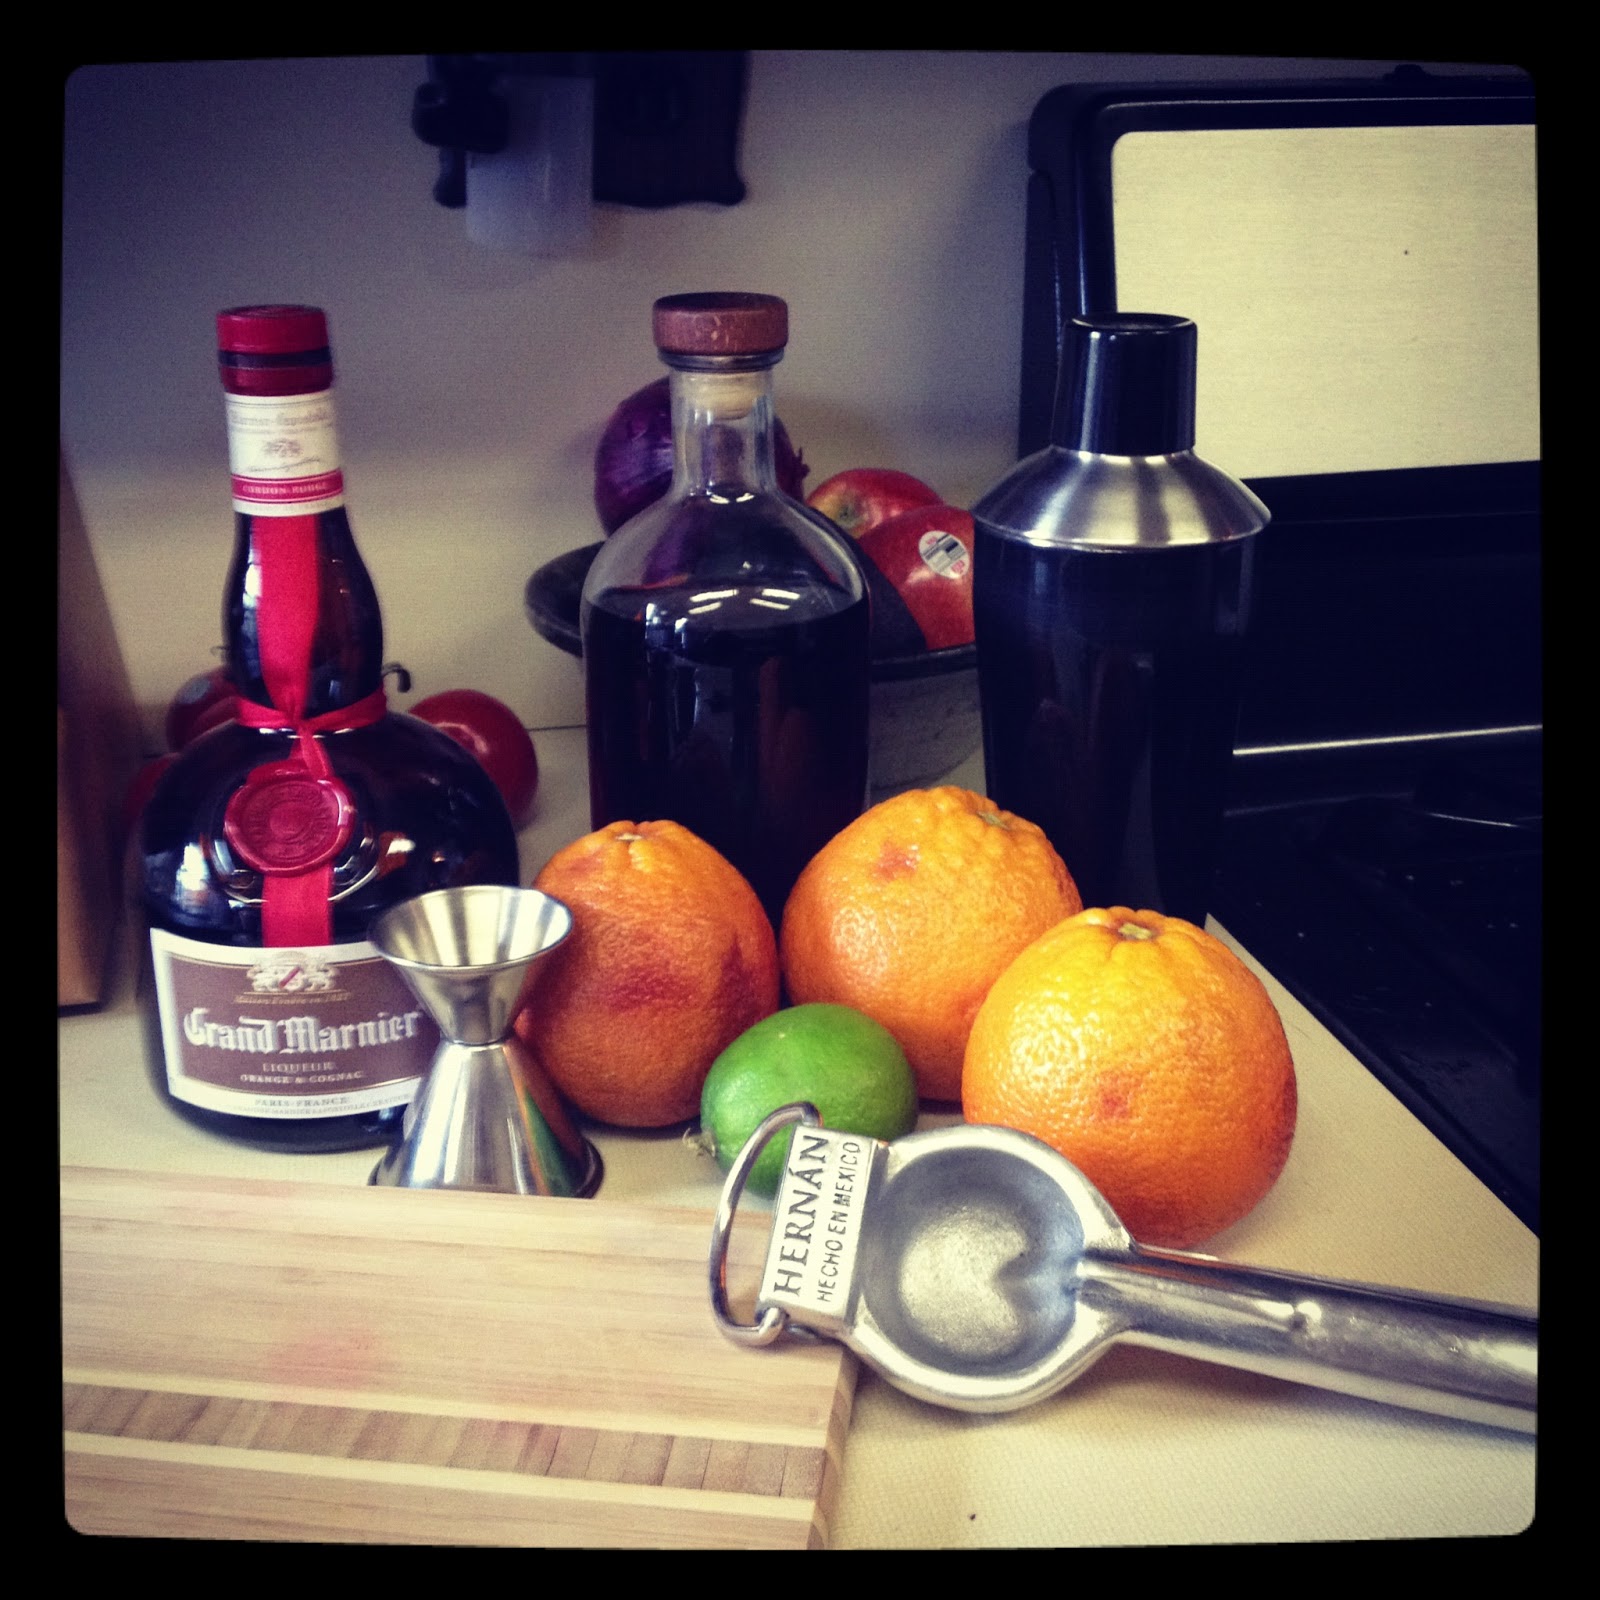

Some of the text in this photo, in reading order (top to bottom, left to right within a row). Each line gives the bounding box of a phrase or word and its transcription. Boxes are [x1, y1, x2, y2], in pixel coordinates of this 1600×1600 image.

[183, 1007, 420, 1054] Grand Marnier
[240, 1071, 363, 1084] ORANGE & COGNAC
[262, 1062, 335, 1074] LIQUEUR
[773, 1135, 829, 1297] HERNÁN
[817, 1141, 861, 1302] HECHO EN MEXICO
